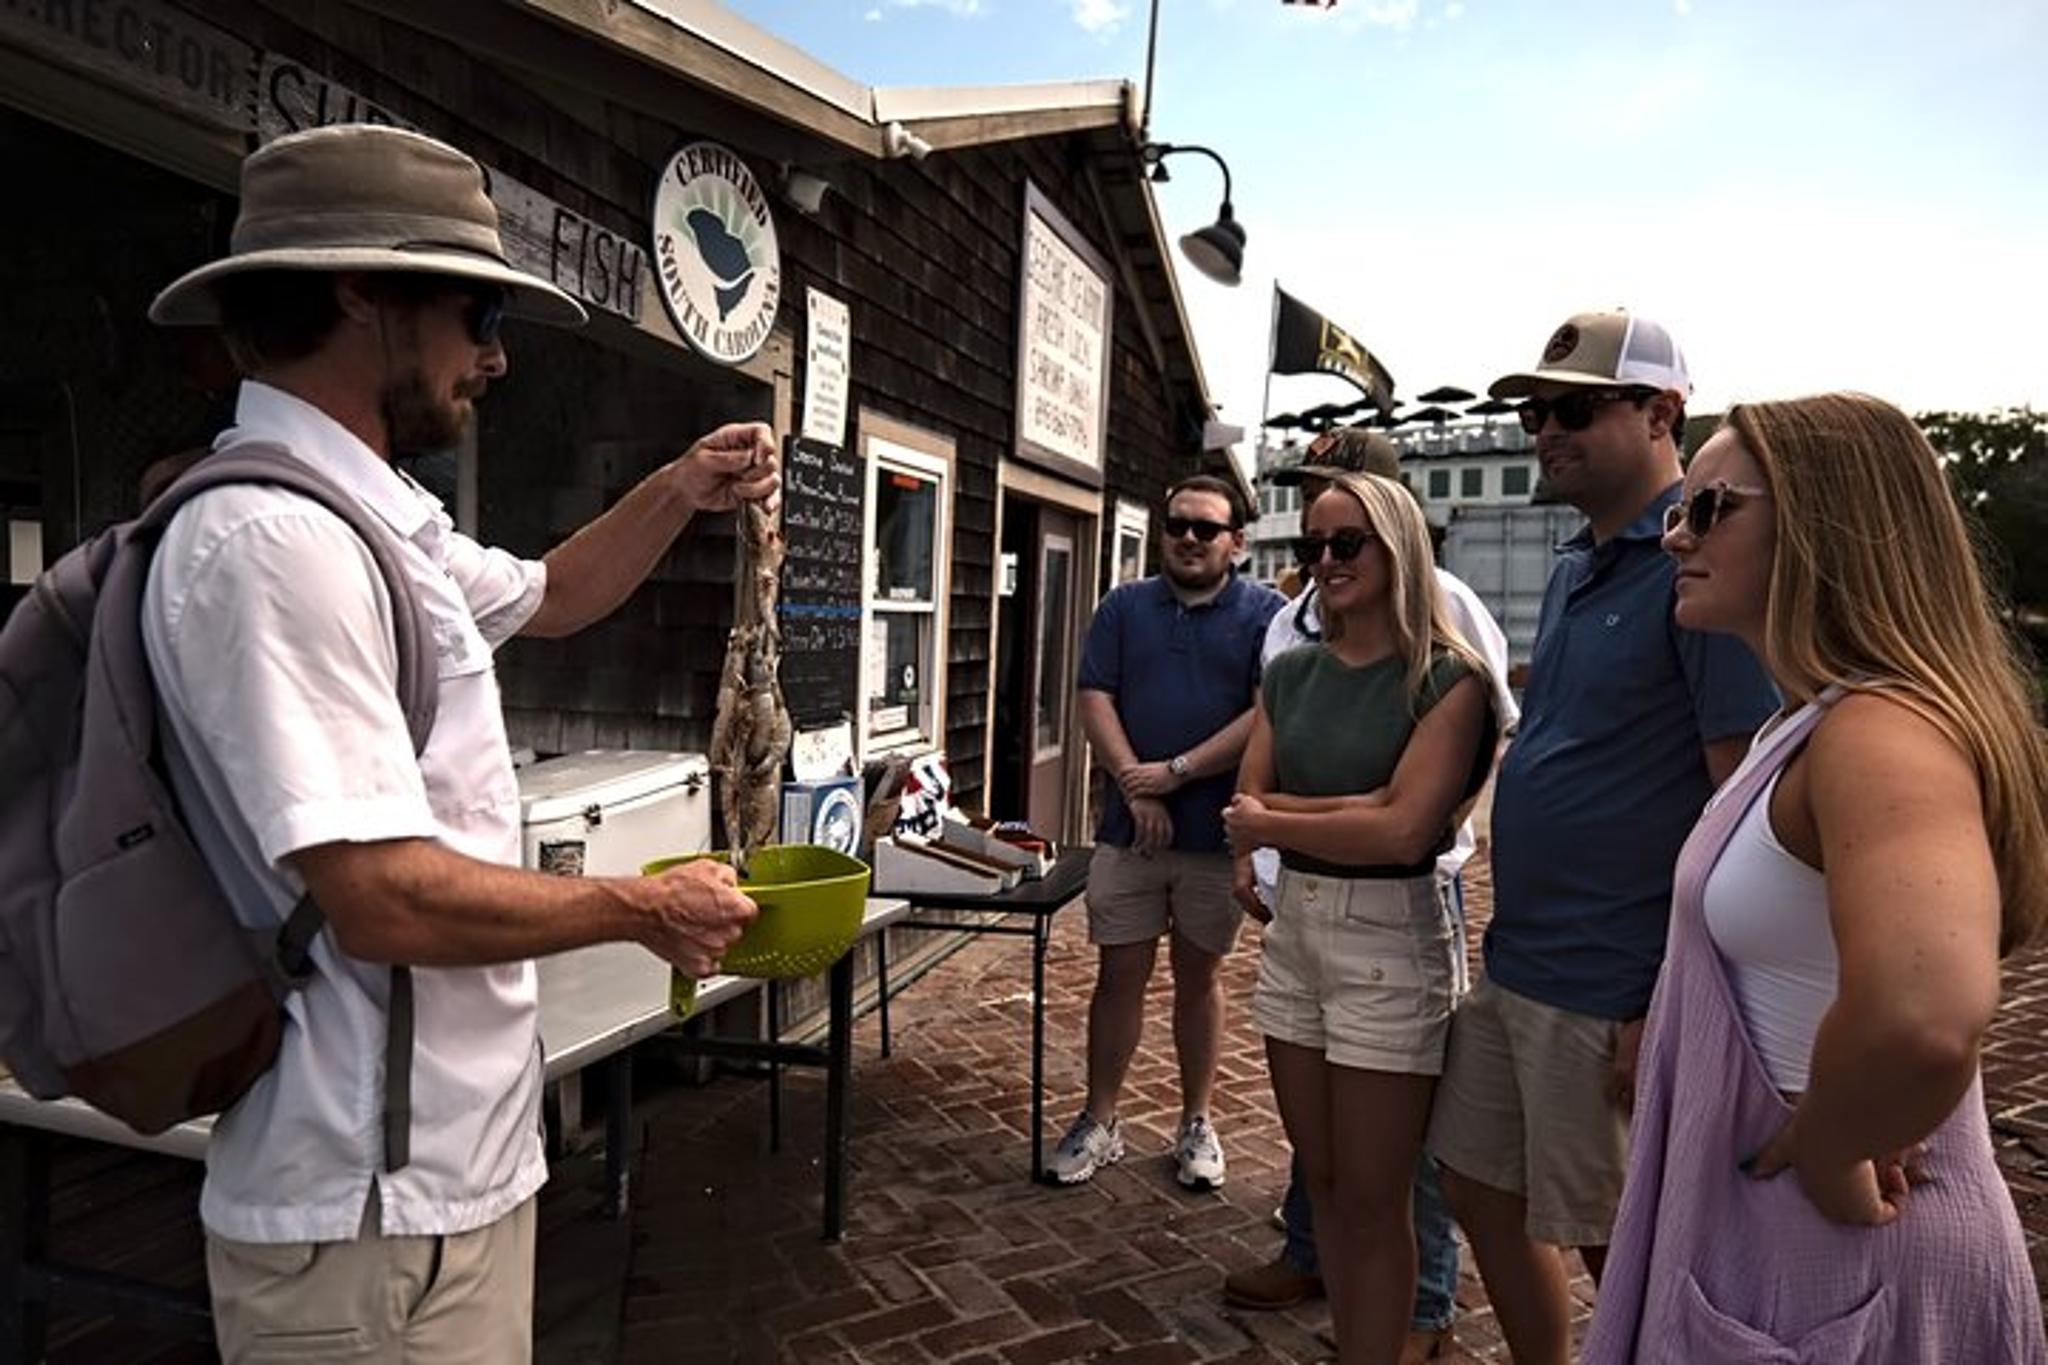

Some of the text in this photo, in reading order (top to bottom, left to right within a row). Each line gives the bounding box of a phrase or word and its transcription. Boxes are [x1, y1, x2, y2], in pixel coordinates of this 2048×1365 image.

[675, 148, 768, 227] CERTIFIED
[551, 207, 641, 318] FISH
[657, 233, 778, 357] SOUTH CAROLINA
